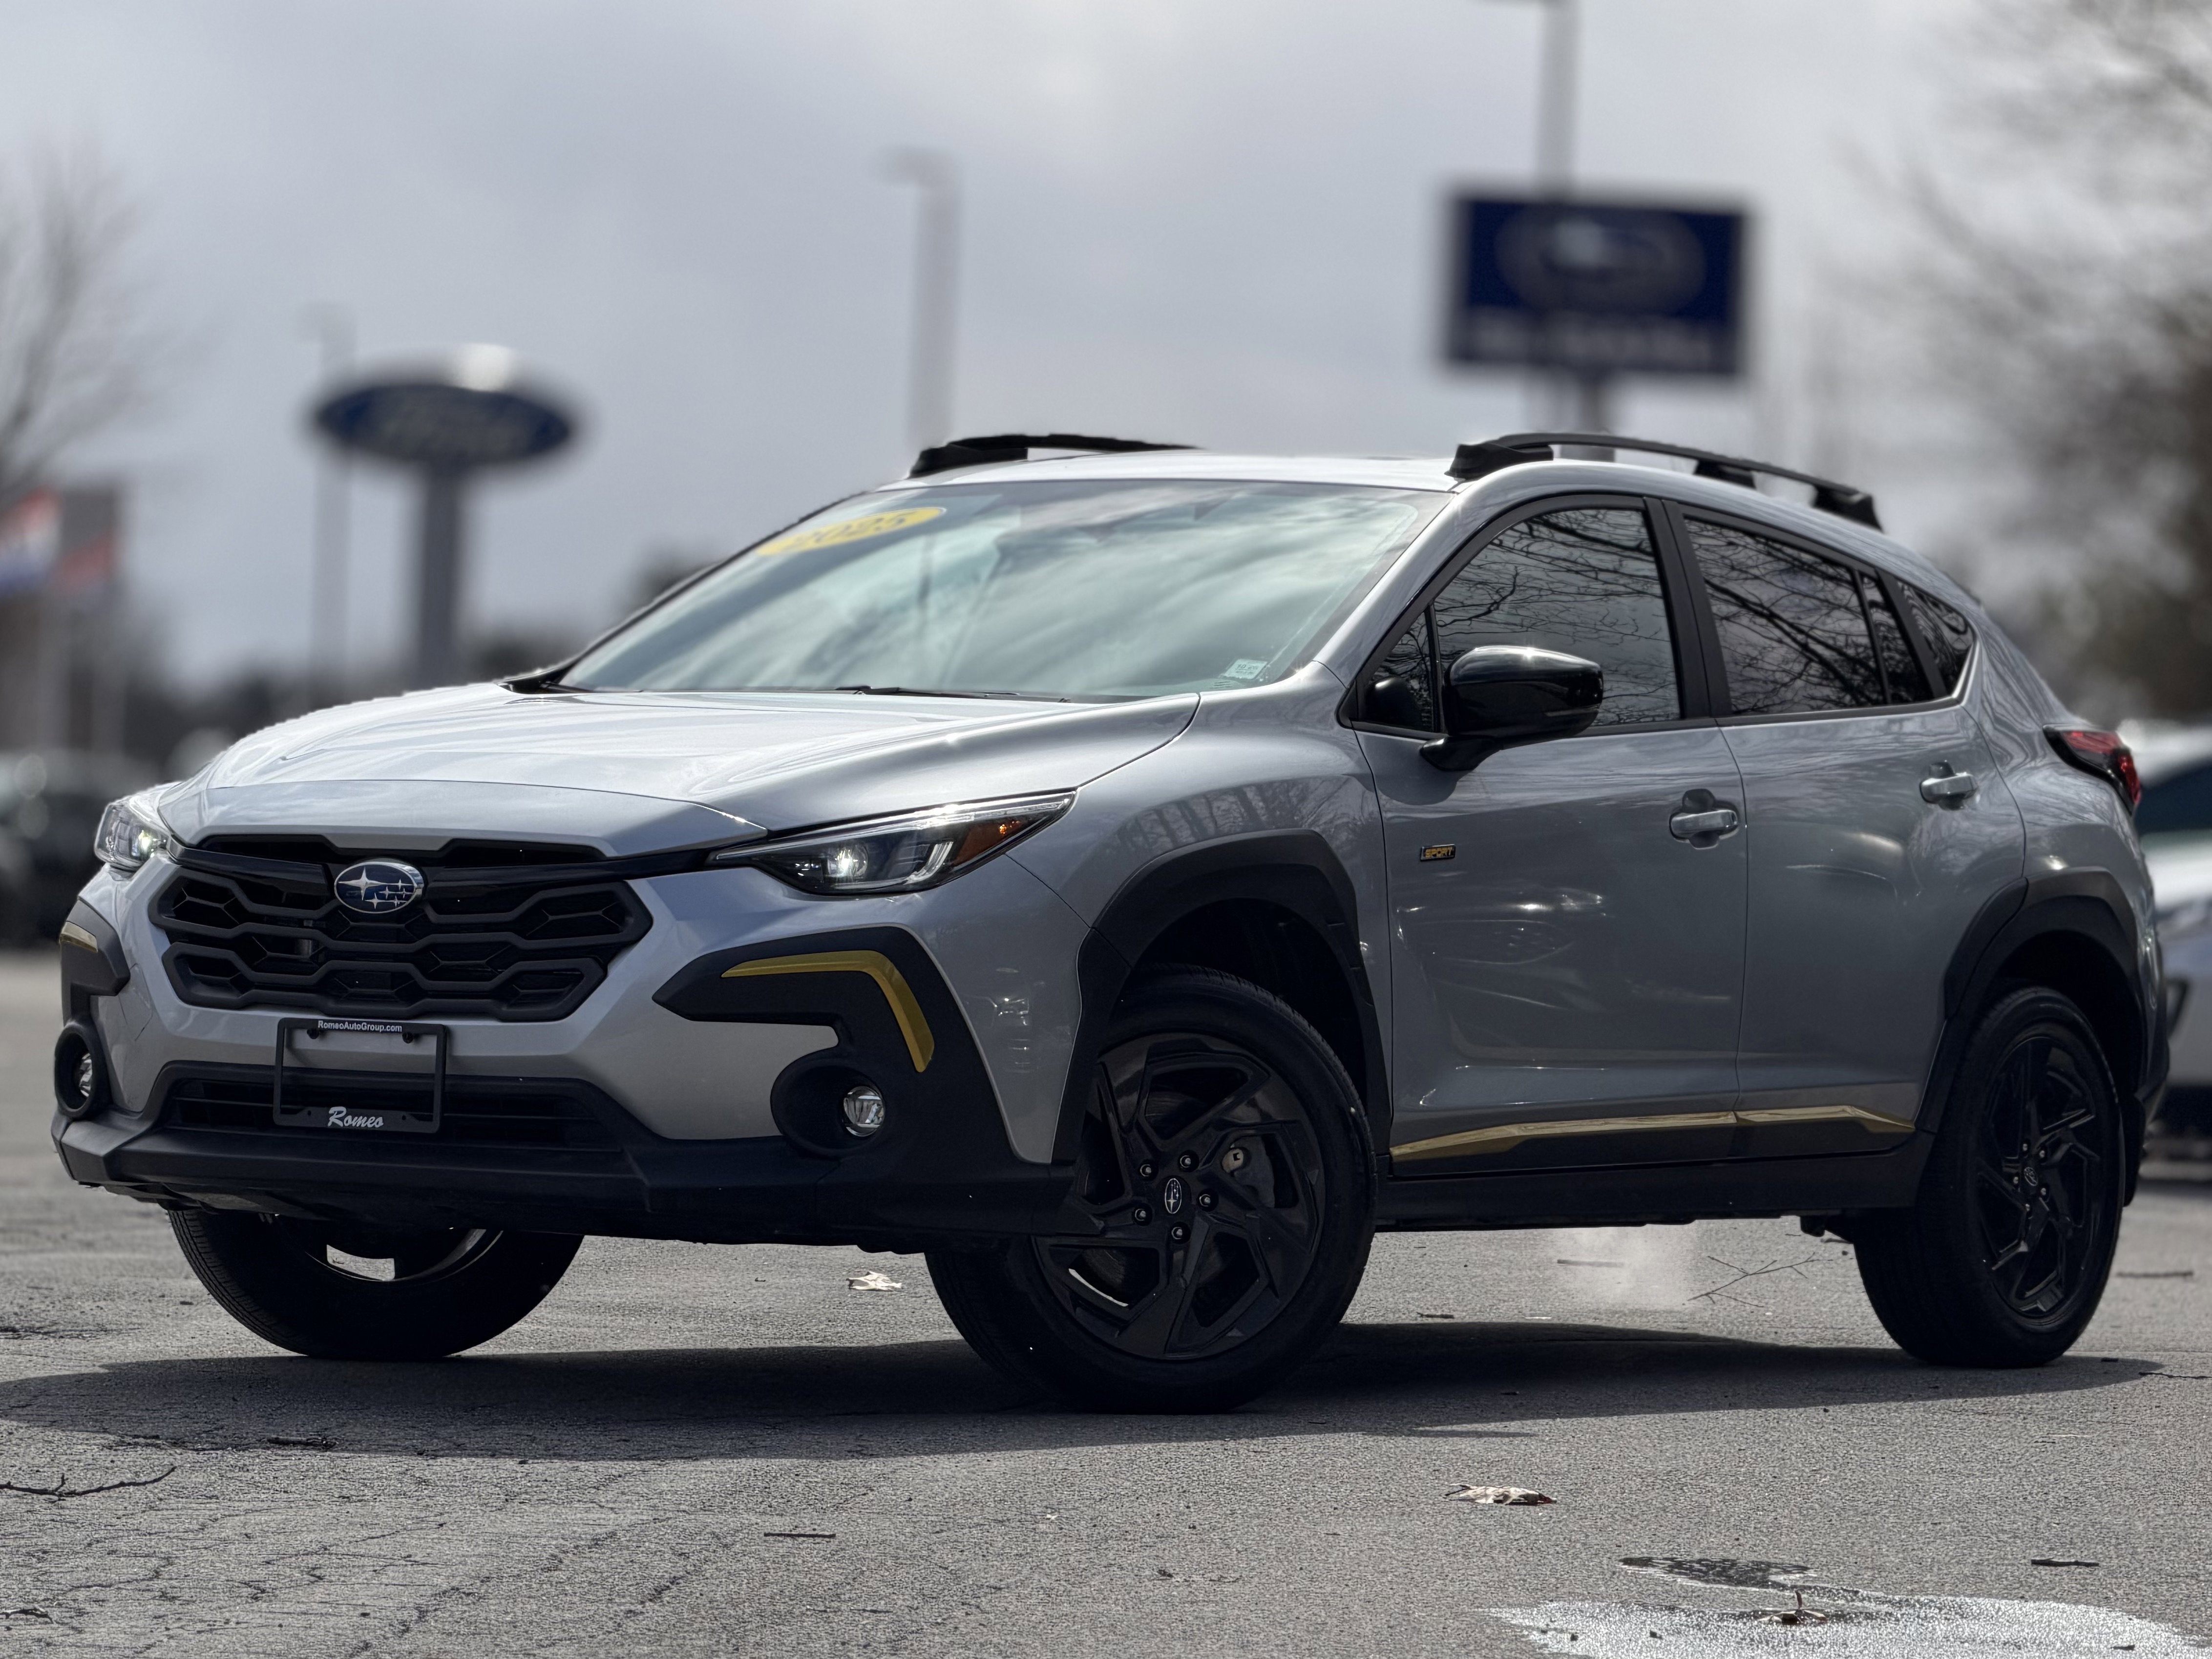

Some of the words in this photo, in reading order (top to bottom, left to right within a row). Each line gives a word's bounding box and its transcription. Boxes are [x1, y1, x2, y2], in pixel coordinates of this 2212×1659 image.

[1425, 847, 1454, 858] SPORT
[318, 1020, 402, 1032] RomeoAutoGroup.com
[328, 1106, 384, 1128] Romeo
